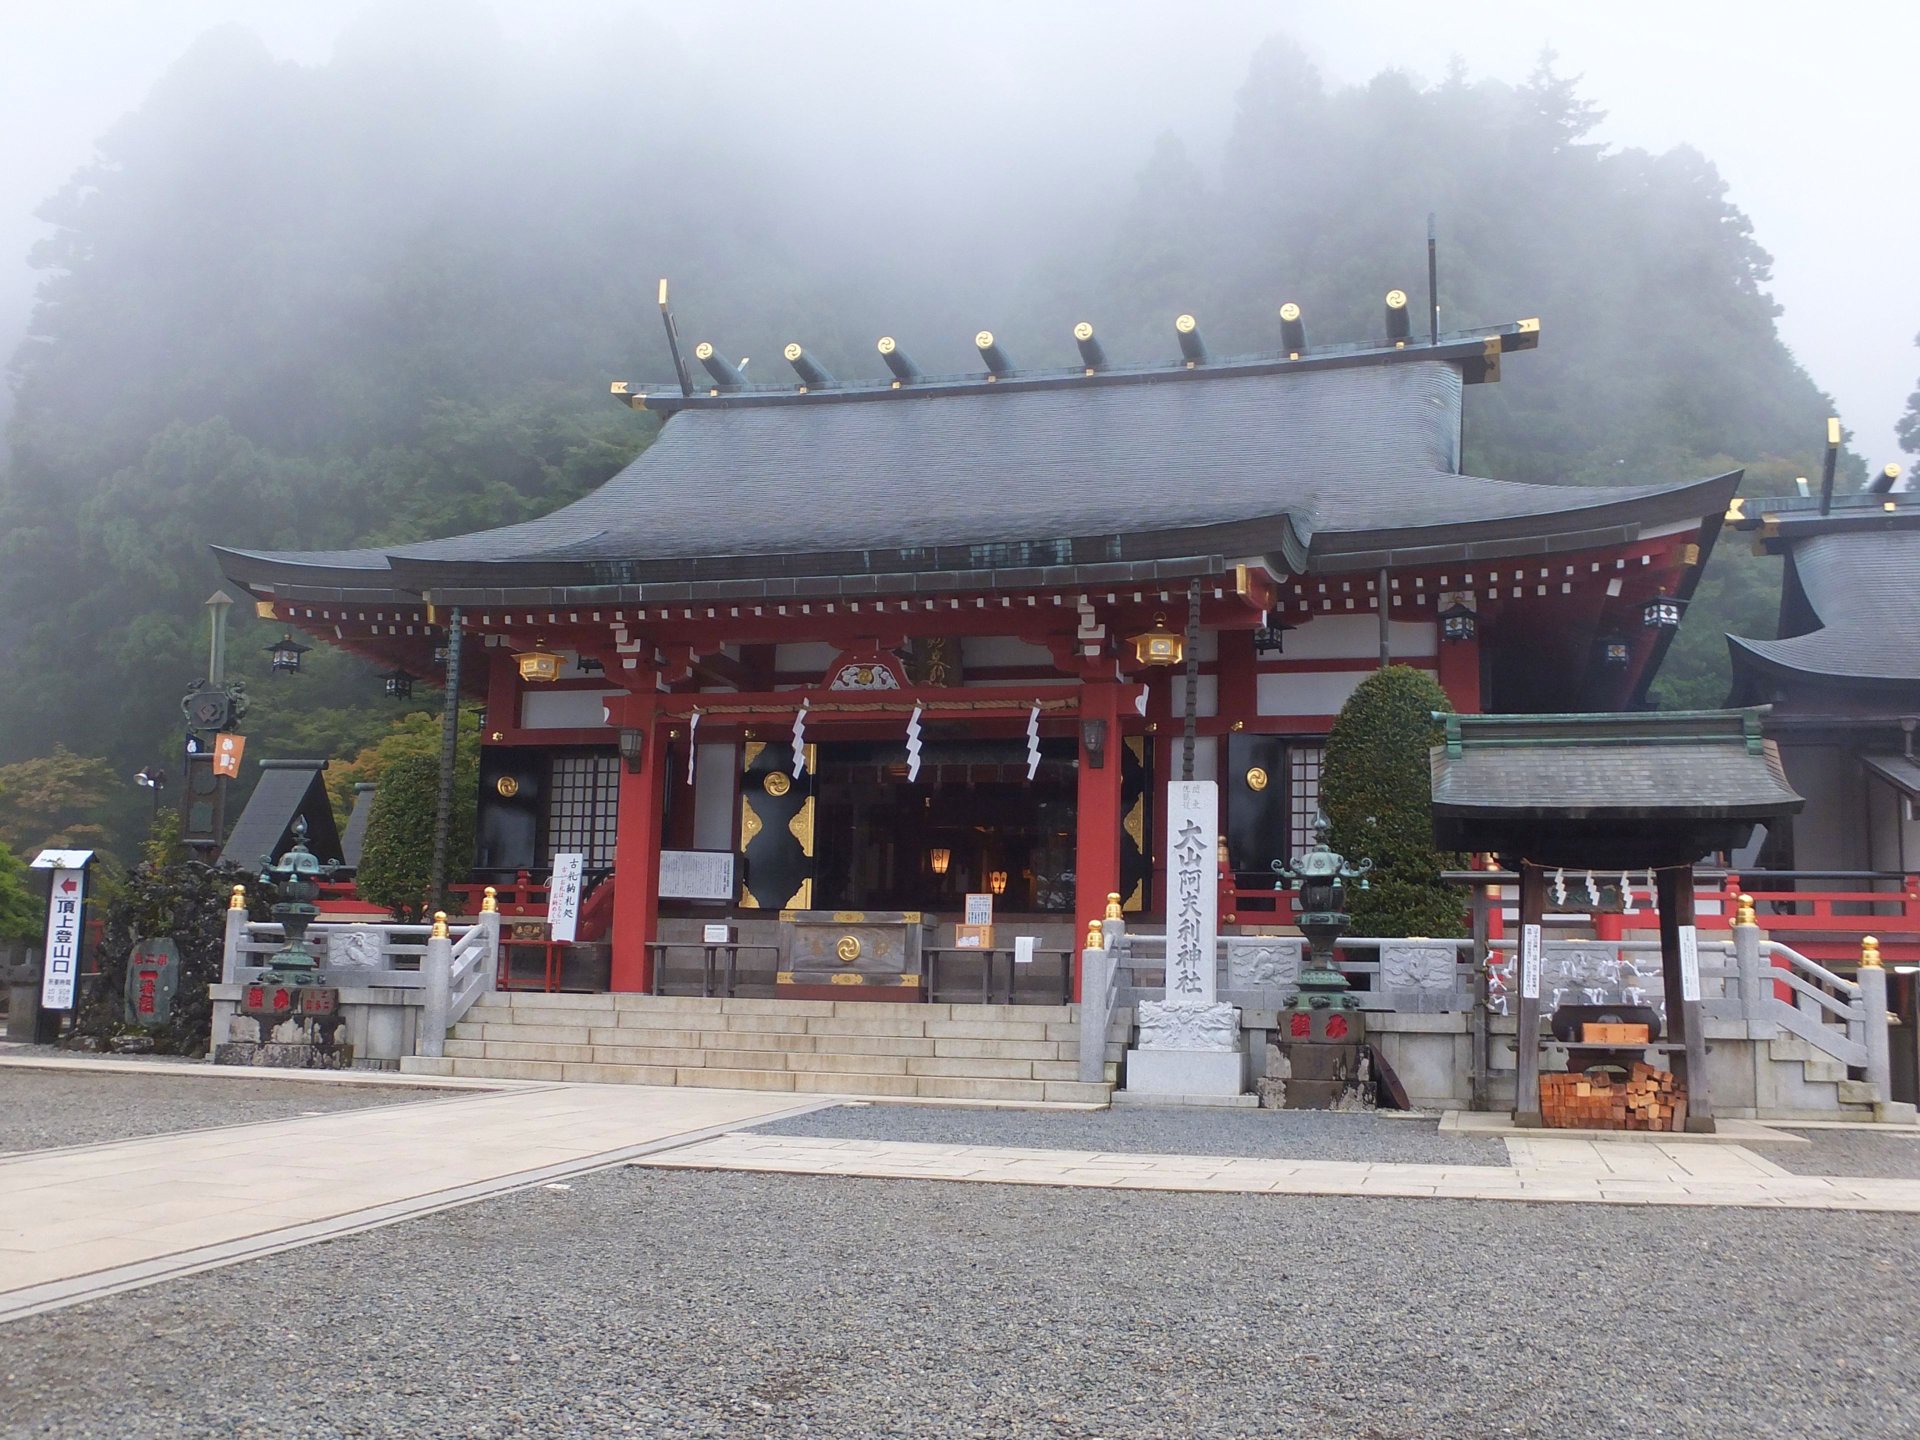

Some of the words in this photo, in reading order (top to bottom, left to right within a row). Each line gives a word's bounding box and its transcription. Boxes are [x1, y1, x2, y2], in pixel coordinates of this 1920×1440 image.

[562, 858, 579, 919] 古札納札処
[1174, 819, 1207, 993] 大山阿夫利神社
[52, 900, 75, 973] 頂上登山口
